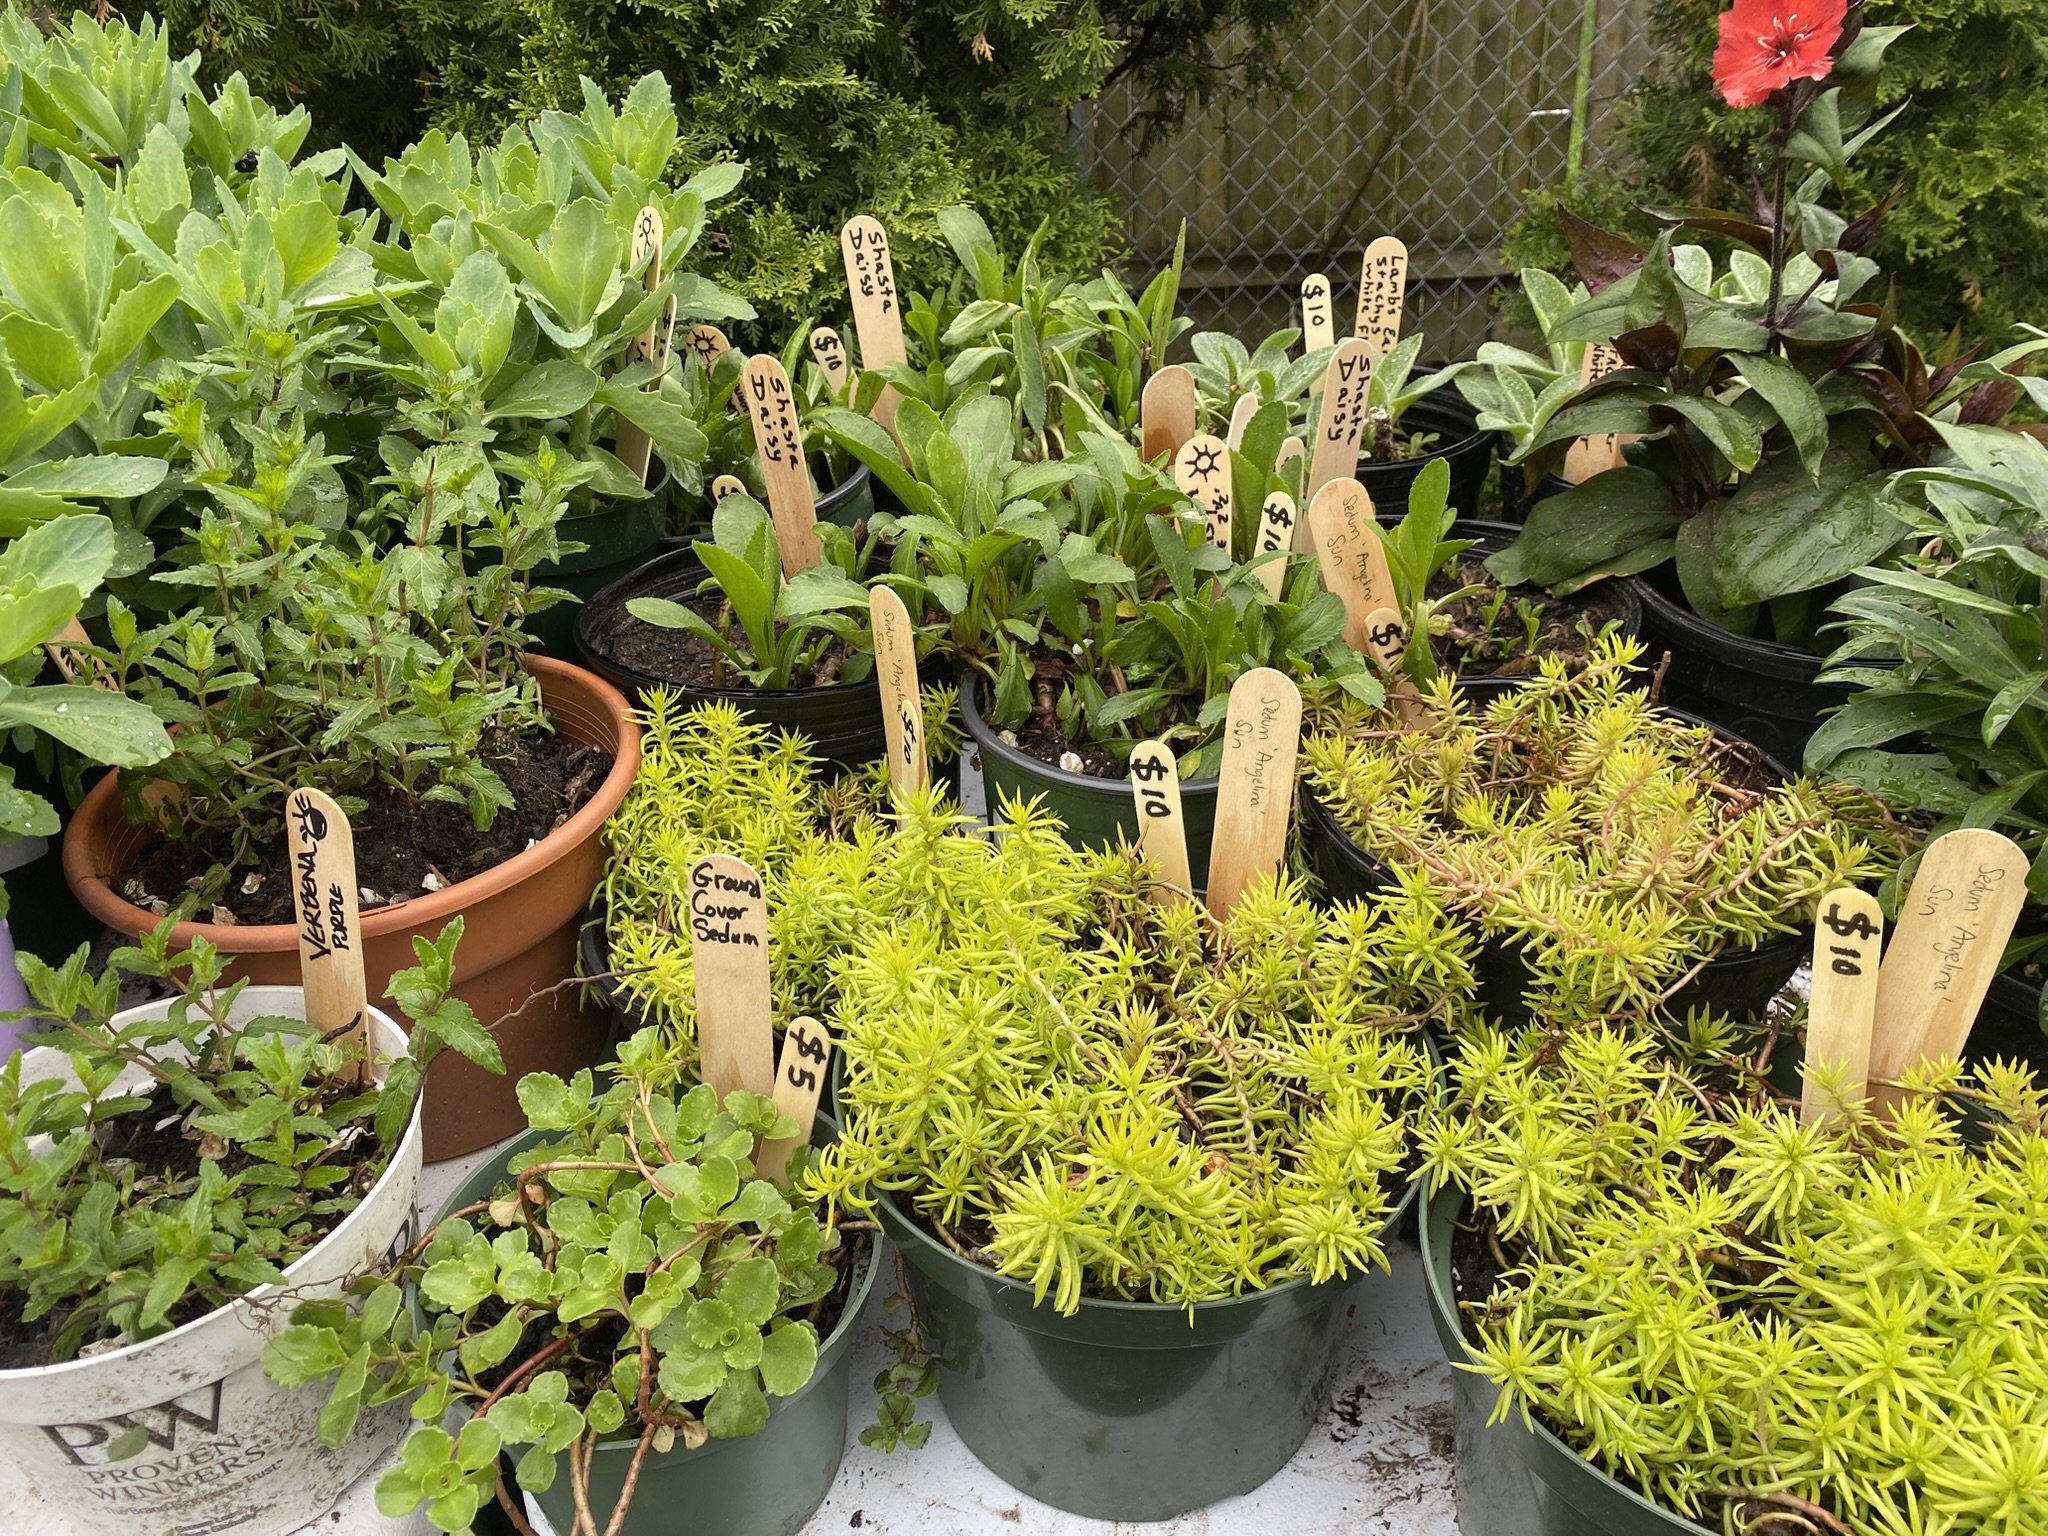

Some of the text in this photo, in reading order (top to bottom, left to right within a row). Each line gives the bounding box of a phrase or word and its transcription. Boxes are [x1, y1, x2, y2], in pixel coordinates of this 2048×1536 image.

[849, 227, 874, 297] Daisy
[868, 231, 894, 314] Shasta
[1301, 284, 1325, 326] $10
[1368, 256, 1388, 335] Stachys
[814, 335, 843, 372] $10
[751, 374, 782, 463] Daisy
[1328, 355, 1357, 441] Daisy
[1347, 354, 1370, 446] Shasta
[770, 377, 799, 471] Shasta
[1264, 503, 1293, 551] $10
[1342, 494, 1361, 541] Sedum
[1327, 534, 1342, 567] Sun
[1369, 623, 1405, 661] $1
[901, 709, 918, 765] $10
[1232, 719, 1253, 749] Sun
[1259, 697, 1281, 740] Sedum
[1131, 755, 1172, 818] $10
[297, 842, 331, 961] VERBENA
[691, 889, 748, 920] Cover
[692, 862, 761, 899] Ground
[1918, 884, 1954, 916] Sun
[1964, 863, 2006, 912] Sedum
[692, 918, 759, 947] Sedum
[1822, 903, 1880, 976] $10
[789, 1026, 827, 1093] $5
[84, 1433, 247, 1484] PROVEN
[86, 1444, 266, 1501] WINNERS
